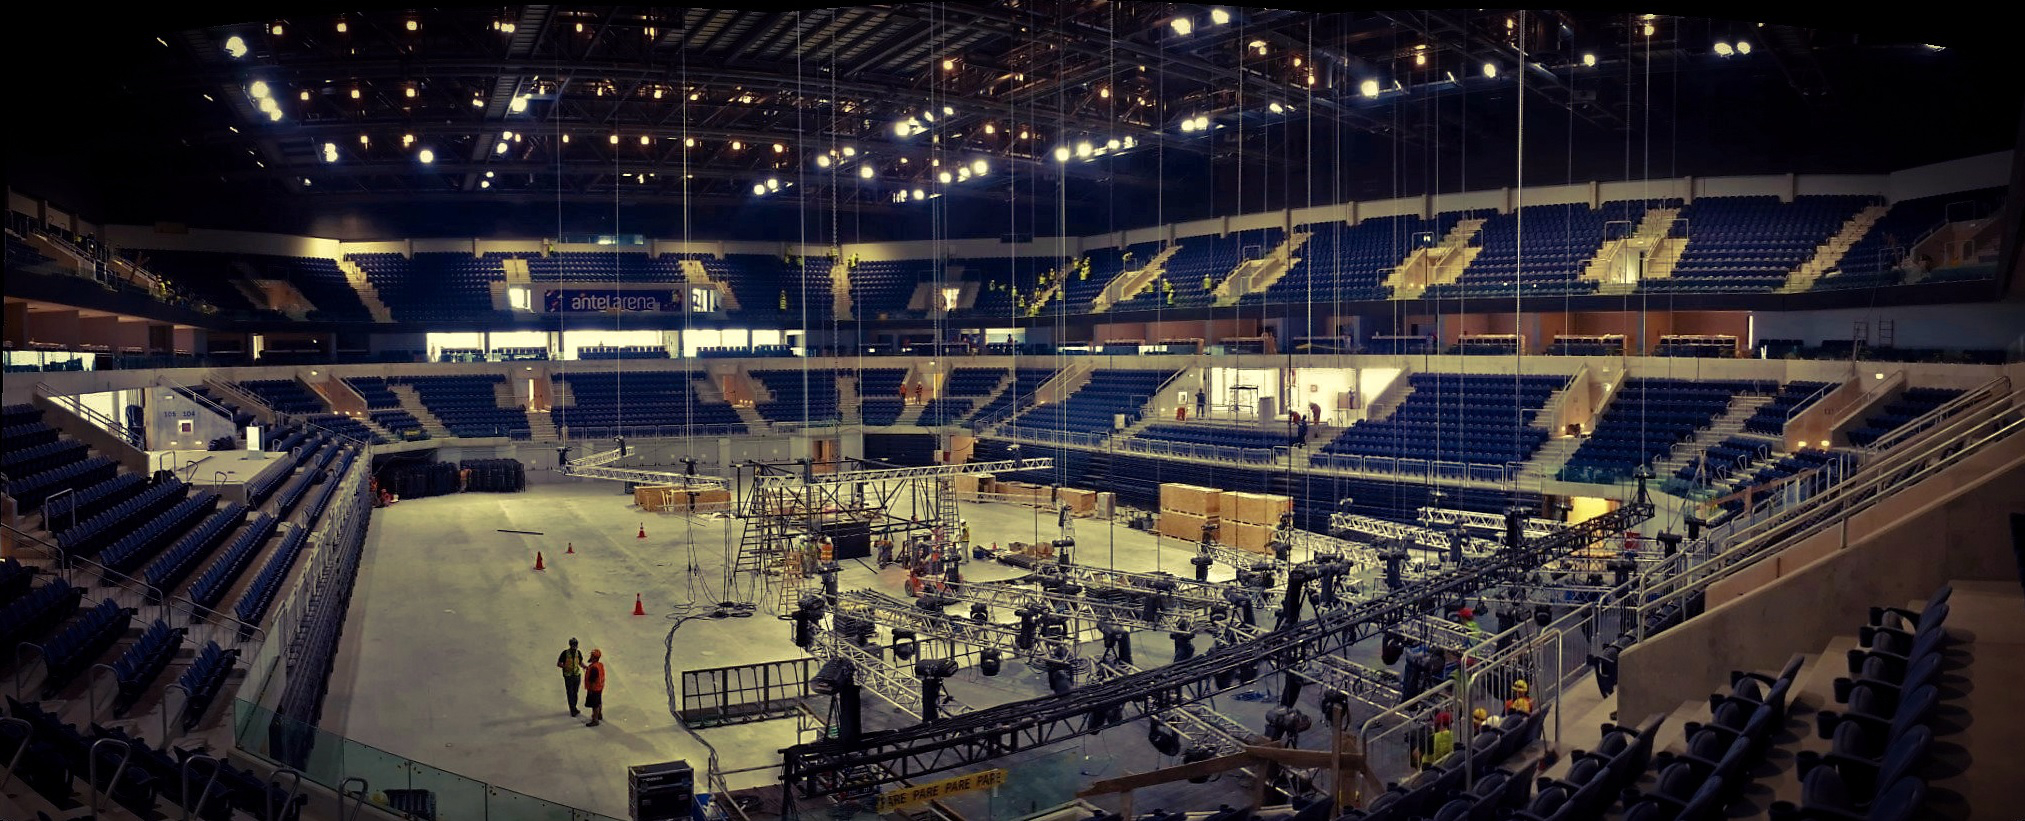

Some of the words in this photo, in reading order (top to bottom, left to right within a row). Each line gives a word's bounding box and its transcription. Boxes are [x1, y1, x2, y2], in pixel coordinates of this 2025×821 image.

[571, 295, 611, 310] antel
[612, 296, 655, 310] arena
[912, 785, 939, 800] PARE
[943, 778, 971, 794] PARE
